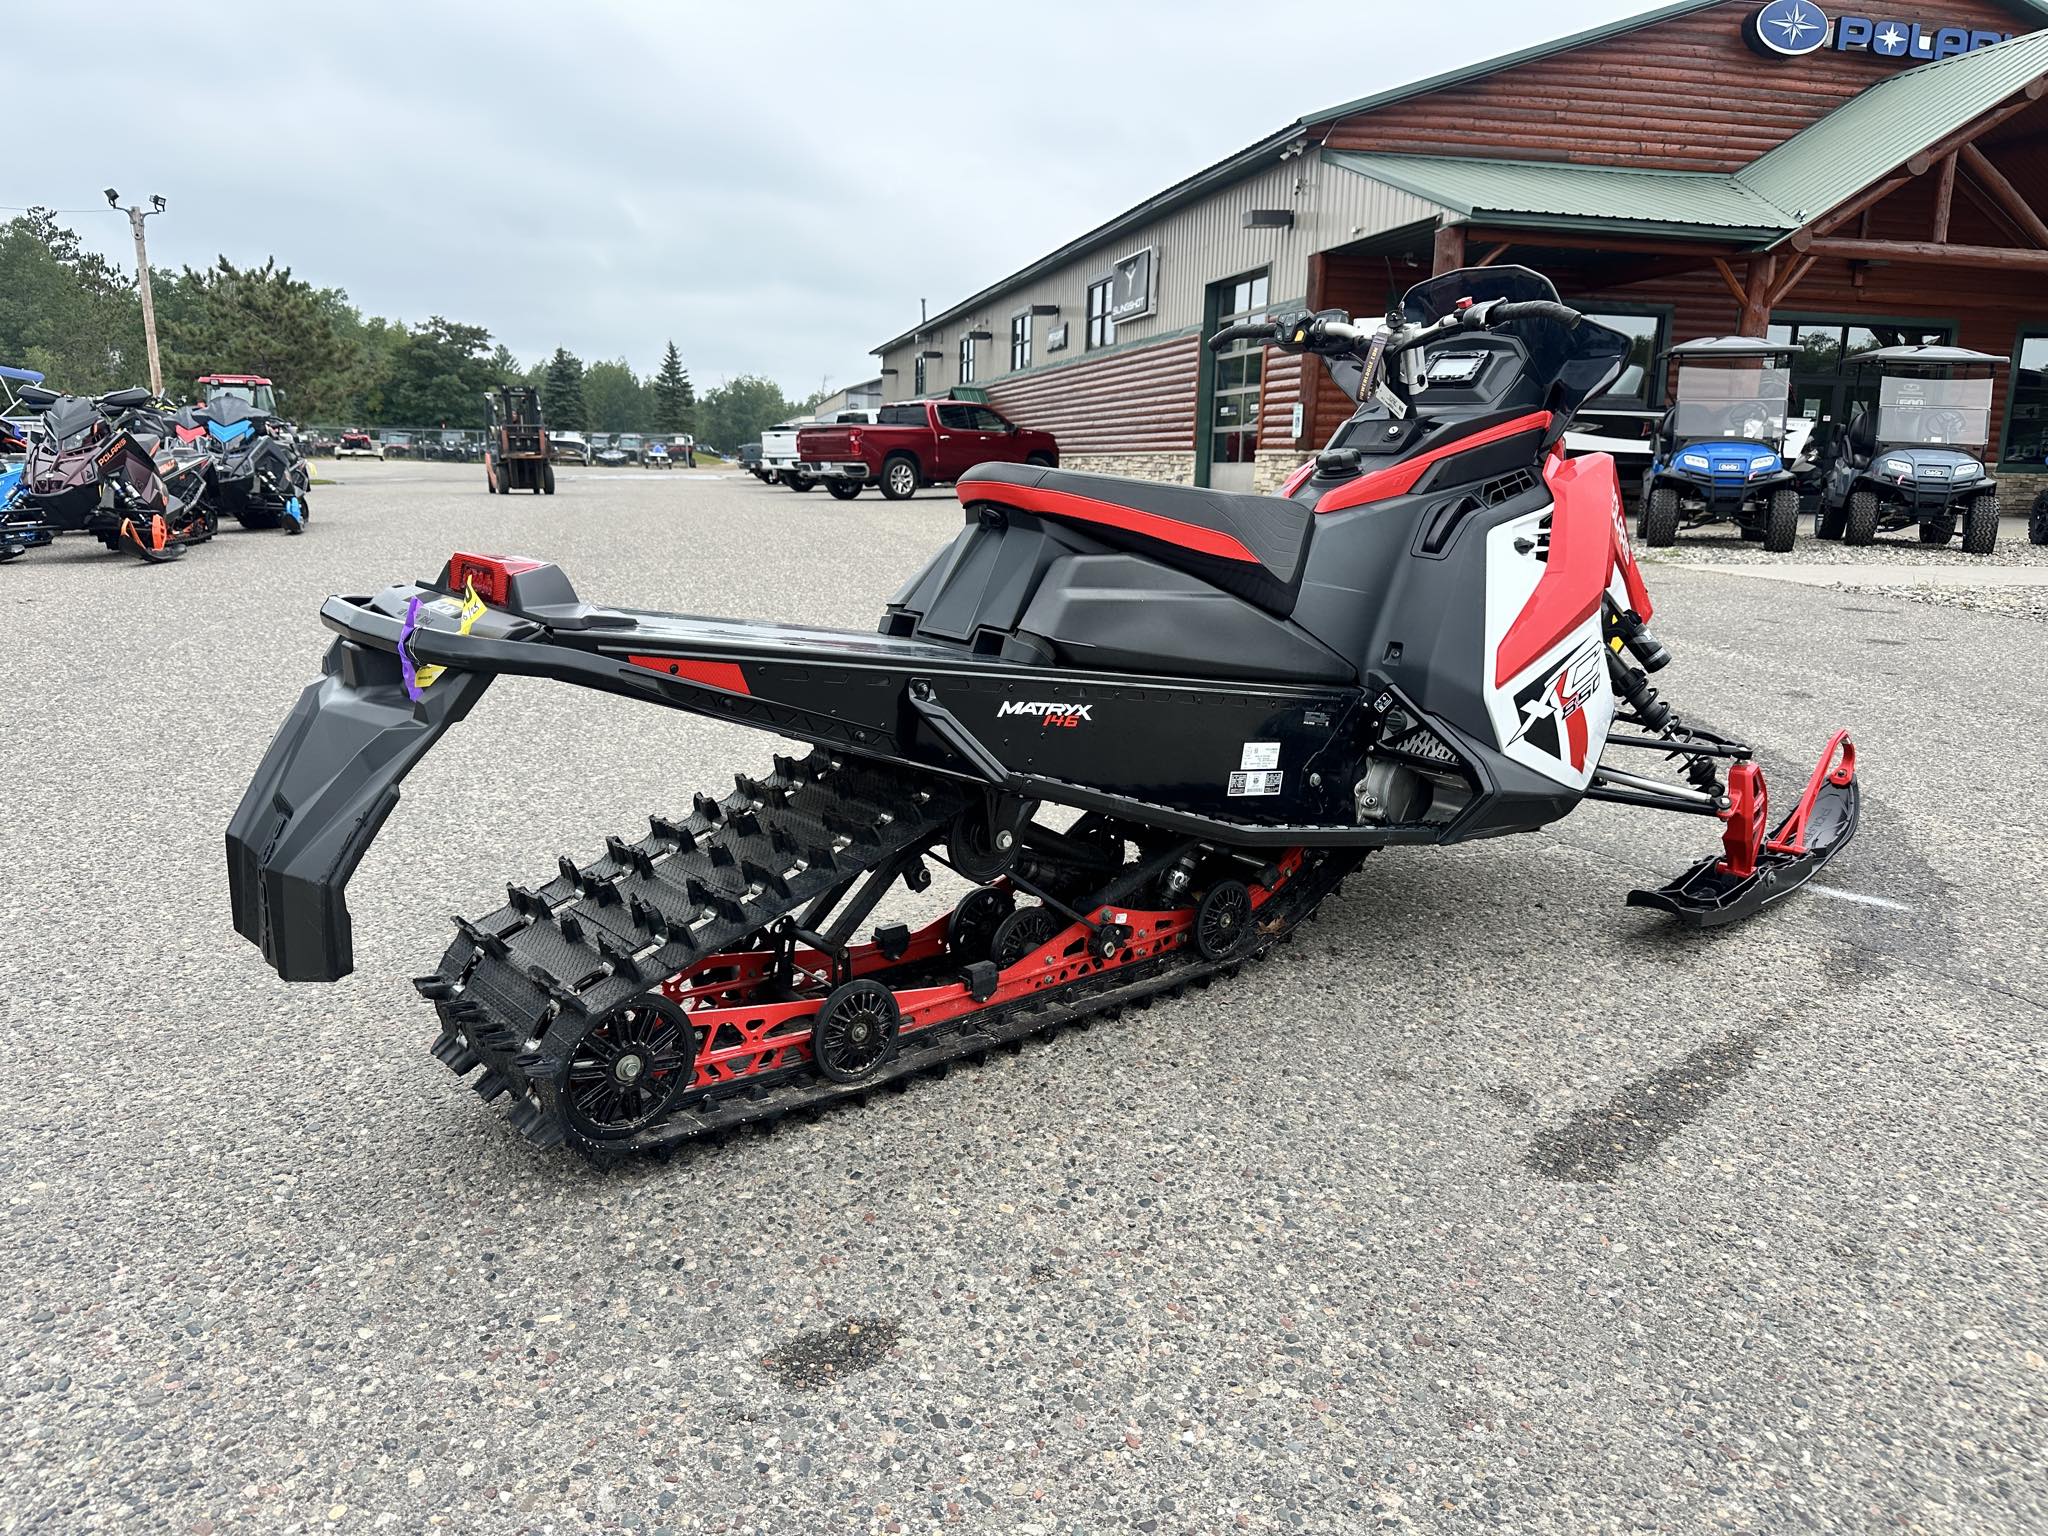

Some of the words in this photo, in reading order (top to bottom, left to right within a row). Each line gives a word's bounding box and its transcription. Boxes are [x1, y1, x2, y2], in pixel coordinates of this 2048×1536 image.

[1838, 16, 2013, 60] POLAR
[98, 438, 127, 467] POLARIS
[996, 701, 1093, 720] MATRYX
[1042, 715, 1080, 727] 146
